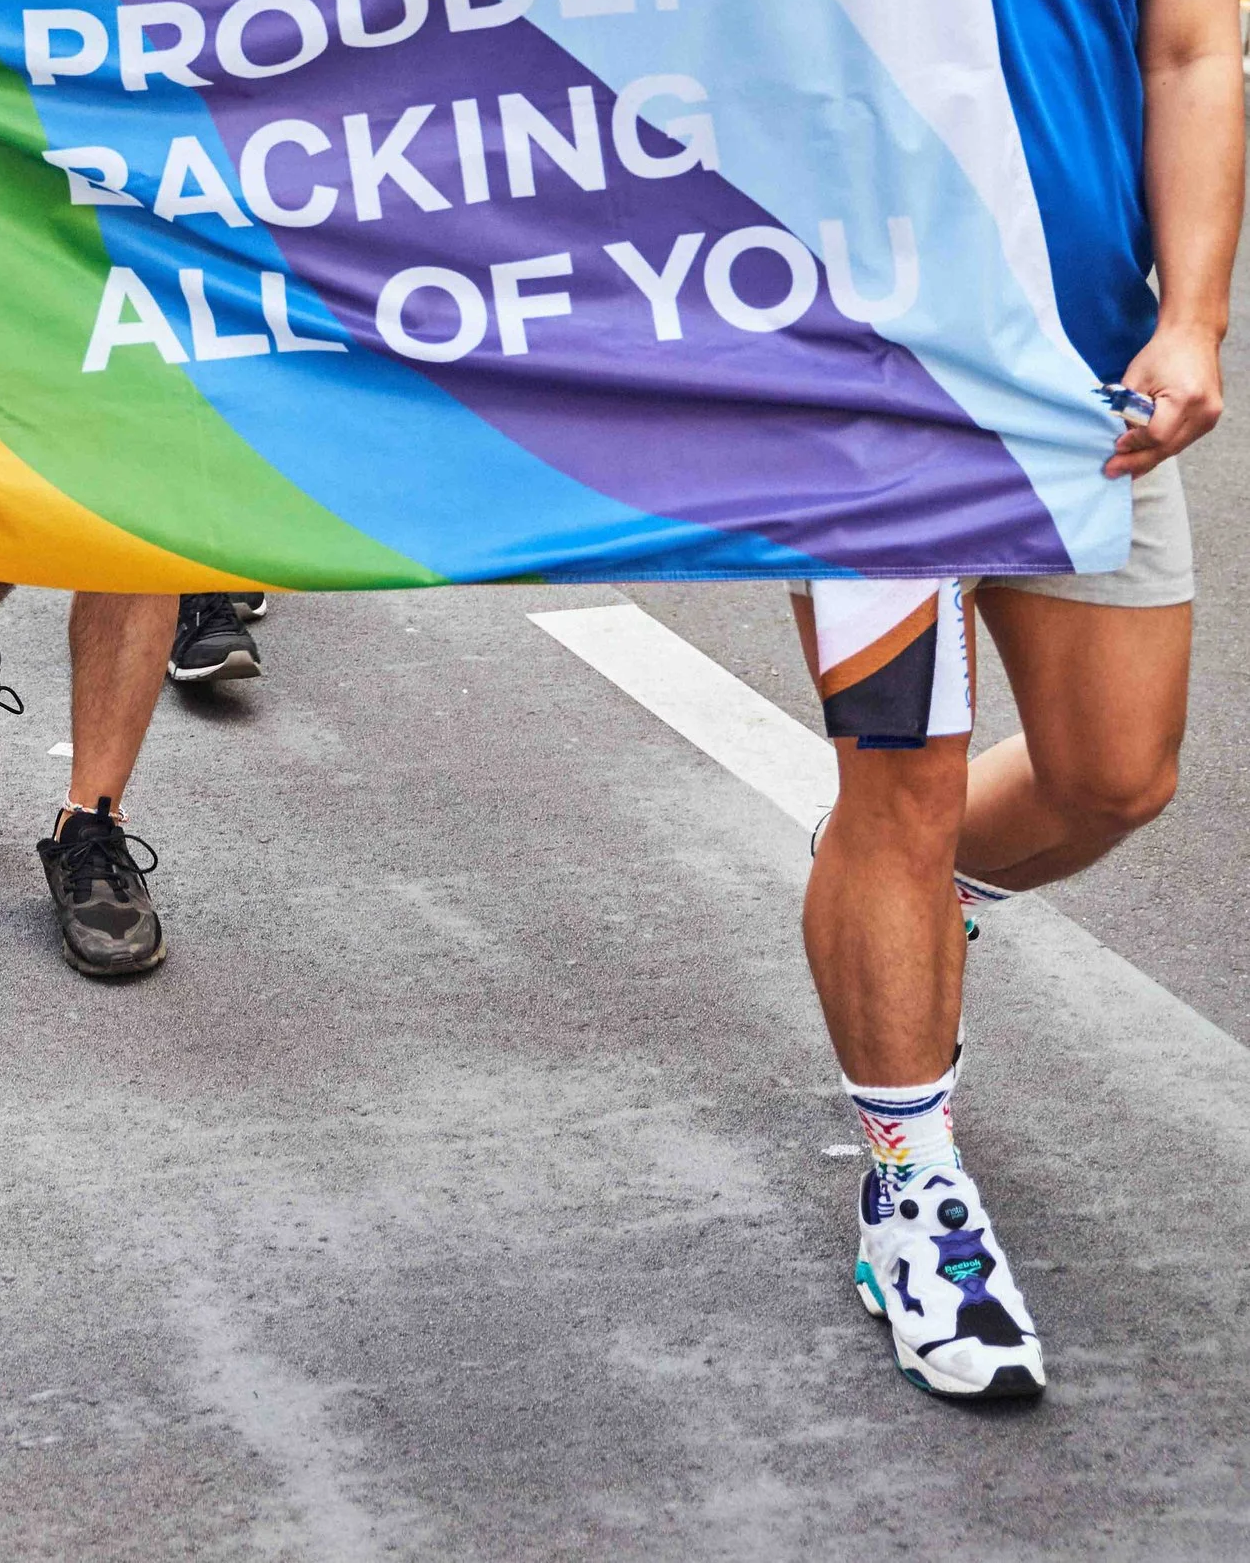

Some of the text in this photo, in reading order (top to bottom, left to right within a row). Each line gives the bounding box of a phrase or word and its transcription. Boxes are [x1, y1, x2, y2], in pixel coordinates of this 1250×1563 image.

[81, 216, 920, 373] ALL OF YOU
[944, 1258, 982, 1274] Reebok
